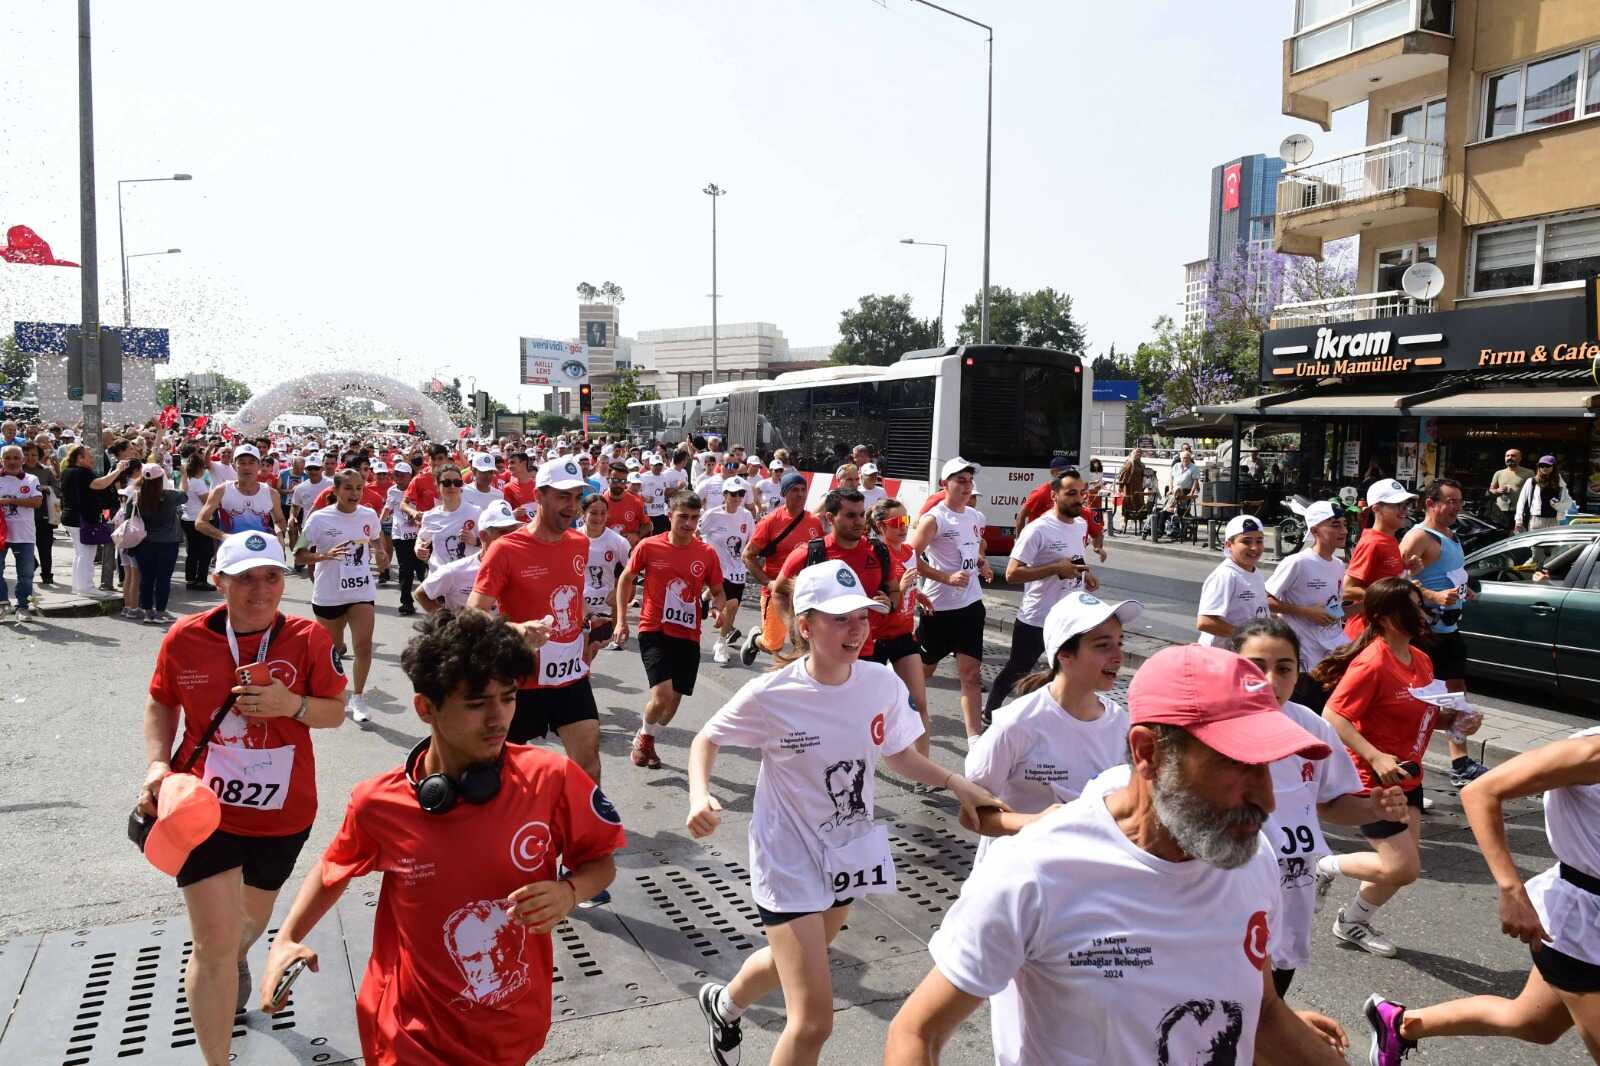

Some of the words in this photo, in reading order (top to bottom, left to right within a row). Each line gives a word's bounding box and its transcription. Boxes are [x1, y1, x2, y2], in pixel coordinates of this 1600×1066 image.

[1478, 349, 1525, 366] Fırın
[1530, 345, 1547, 362] &
[1553, 342, 1600, 361] Cafe
[1296, 360, 1330, 378] Unlu
[1333, 356, 1412, 376] Mamüller
[1008, 472, 1034, 482] ESHOT
[991, 495, 1018, 506] UZUN
[341, 575, 369, 589] 0854
[665, 607, 695, 624] 0103
[209, 776, 280, 806] 0827
[834, 865, 888, 893] 911
[1092, 938, 1102, 947] 19
[1104, 937, 1127, 949] Mayıs
[1124, 945, 1152, 956] Koşusu
[1114, 956, 1154, 968] Belediyesi
[1104, 969, 1124, 978] 2024
